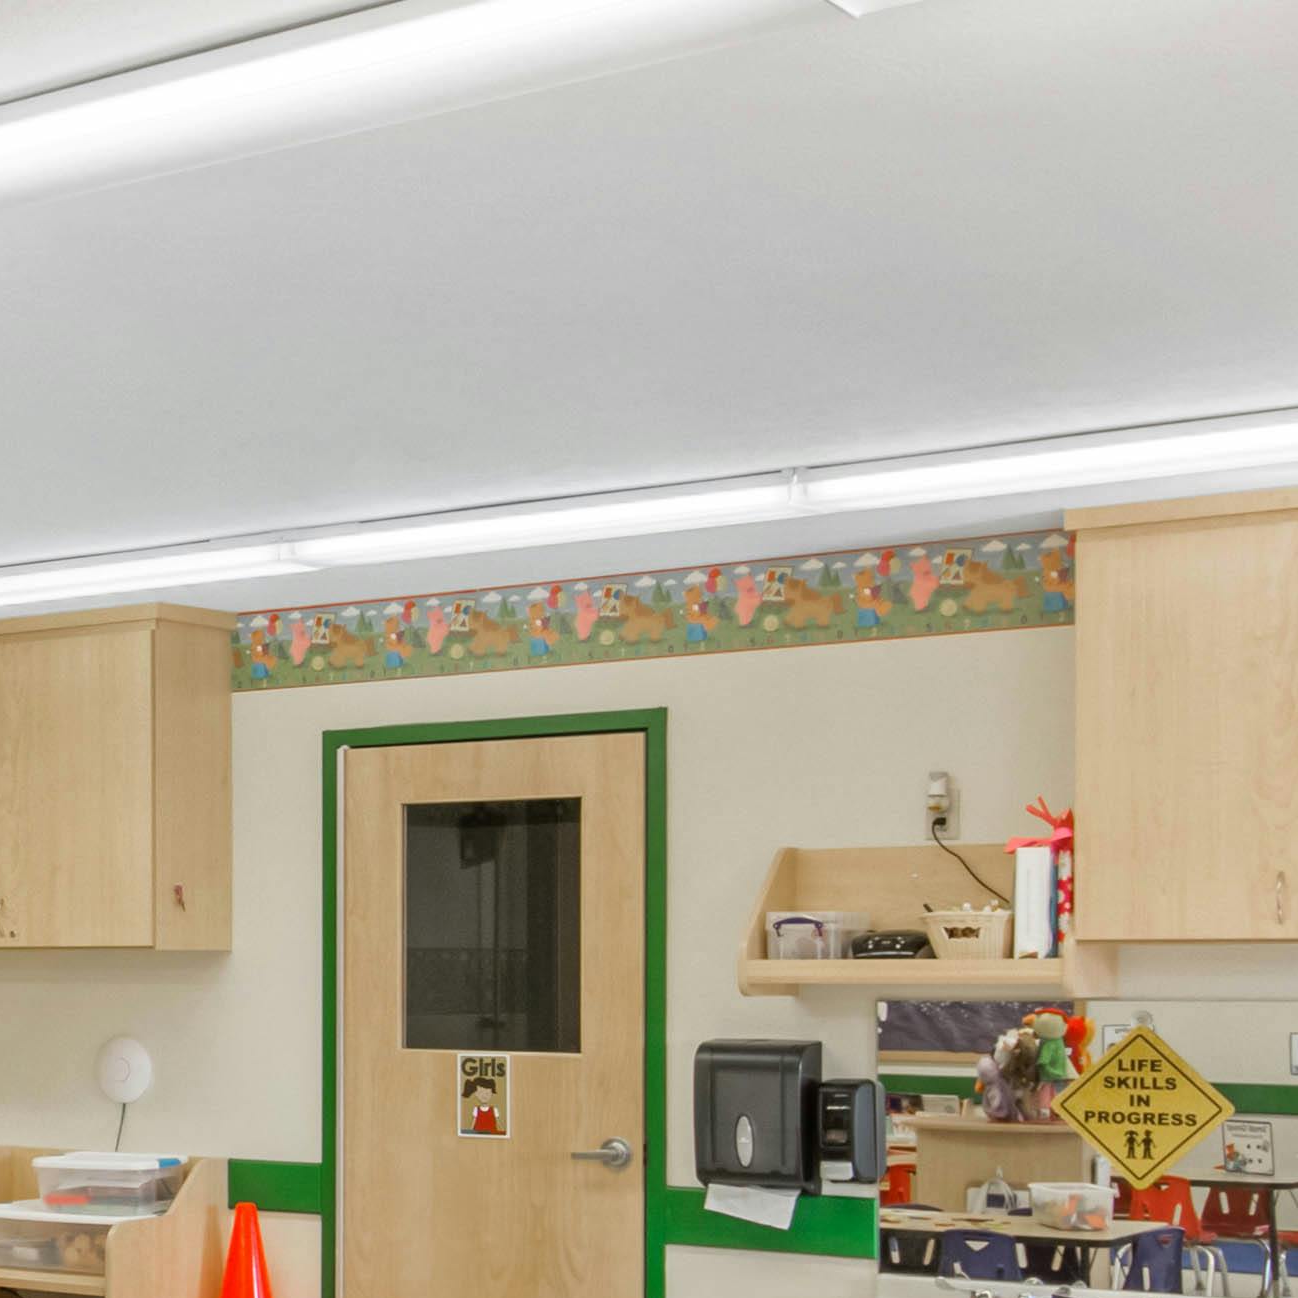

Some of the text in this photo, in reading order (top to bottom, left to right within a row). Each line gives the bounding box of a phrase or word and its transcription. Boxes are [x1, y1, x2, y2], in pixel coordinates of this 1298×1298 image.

[461, 1057, 506, 1077] Girls
[1117, 1058, 1163, 1072] LIFE
[1103, 1075, 1177, 1091] SKILLS
[1128, 1094, 1151, 1107] IN
[1084, 1110, 1197, 1127] PROGRESS
